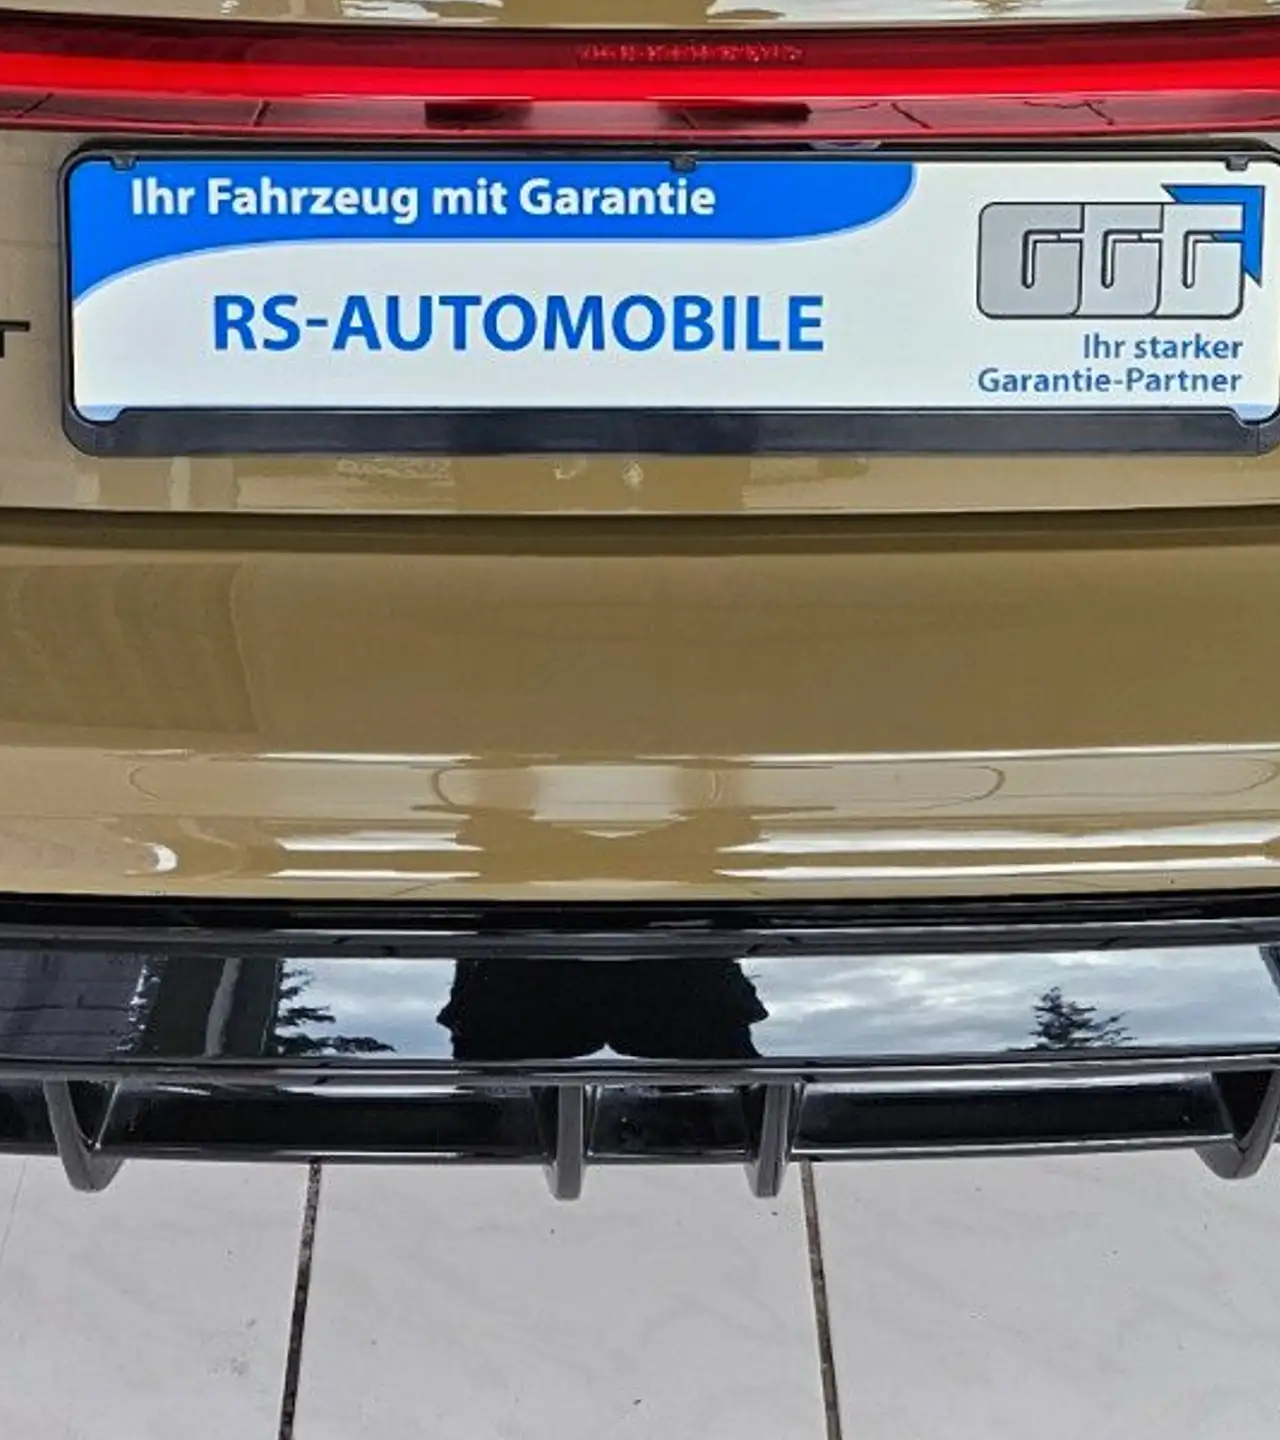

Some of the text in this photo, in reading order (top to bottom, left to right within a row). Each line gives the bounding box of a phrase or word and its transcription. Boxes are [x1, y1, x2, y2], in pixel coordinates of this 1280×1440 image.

[131, 177, 715, 224] Ihr Fahrzeug mit Garantie
[213, 294, 824, 352] RS-AUTOMOBILE
[1083, 333, 1243, 360] Ihr starker
[977, 367, 1243, 394] Garantie-Partner
